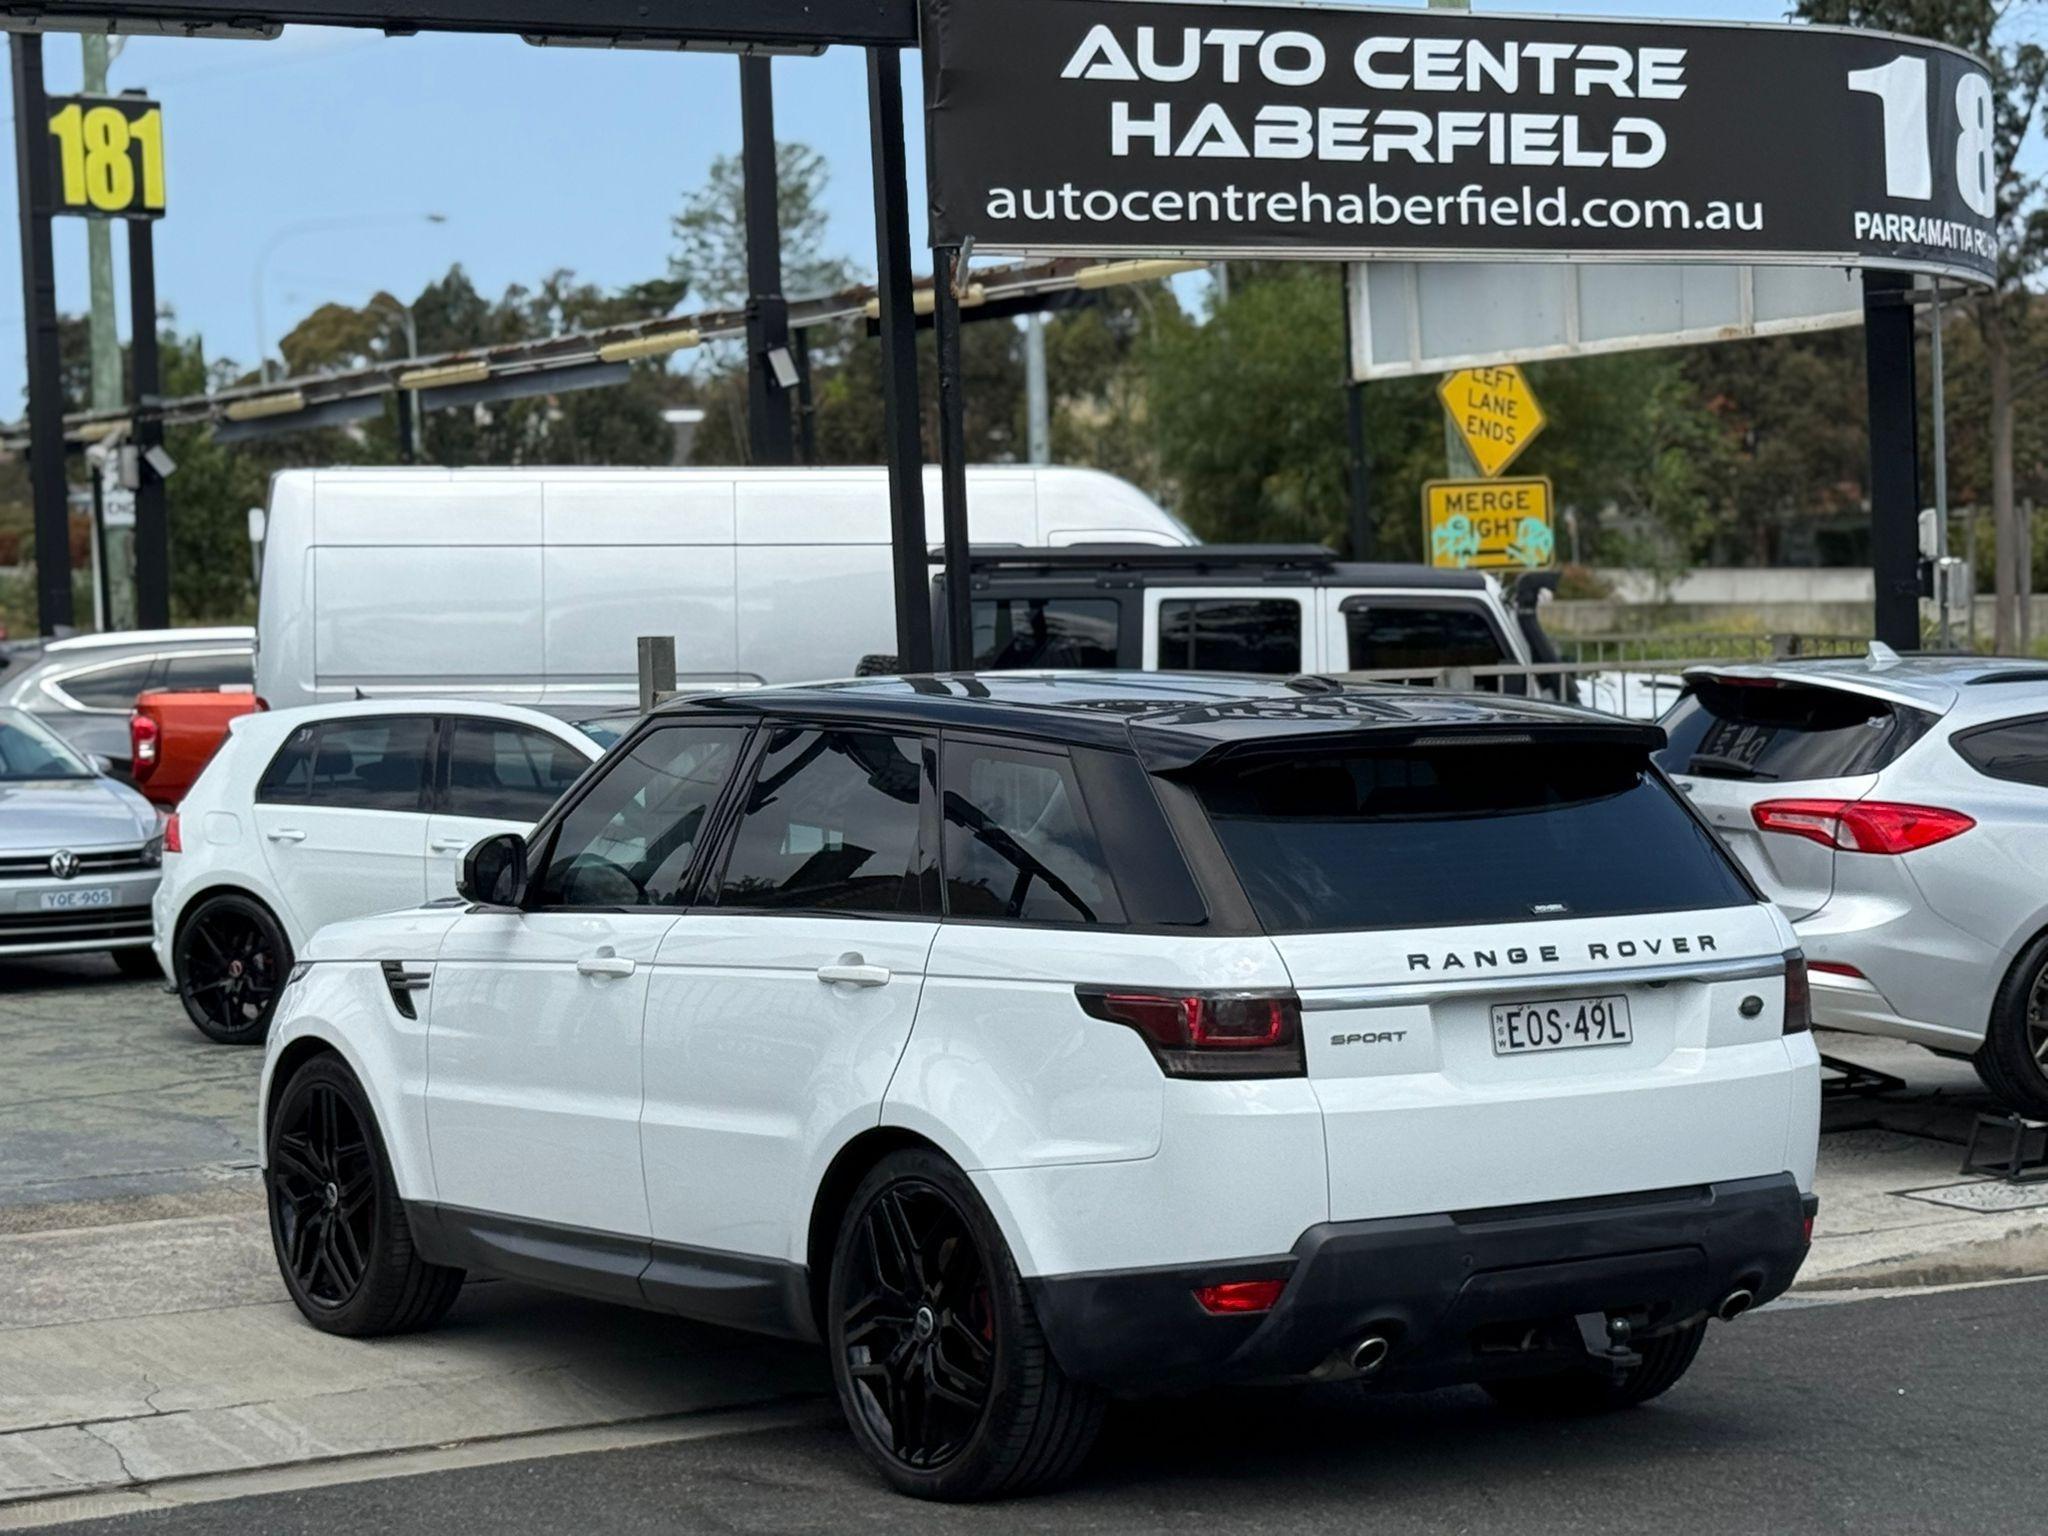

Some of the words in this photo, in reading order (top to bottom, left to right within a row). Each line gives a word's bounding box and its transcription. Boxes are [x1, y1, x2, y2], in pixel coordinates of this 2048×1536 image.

[1061, 24, 1326, 86] AUTO
[1353, 36, 1688, 100] CENTRE
[1111, 101, 1667, 169] HABERFIELD
[48, 103, 165, 211] 181
[986, 181, 1763, 231] autocentrehaberfield.com.au
[1854, 211, 1973, 254] PARRAMATTA
[1472, 367, 1515, 392] LEFT
[1468, 388, 1518, 420] LANE
[1467, 414, 1516, 446] ENDS
[1445, 490, 1531, 513] MERGE
[1451, 518, 1525, 540] IGHT
[1406, 945, 1560, 971] RANGE
[1587, 934, 1718, 961] ROVER
[1330, 1030, 1408, 1046] SPORT
